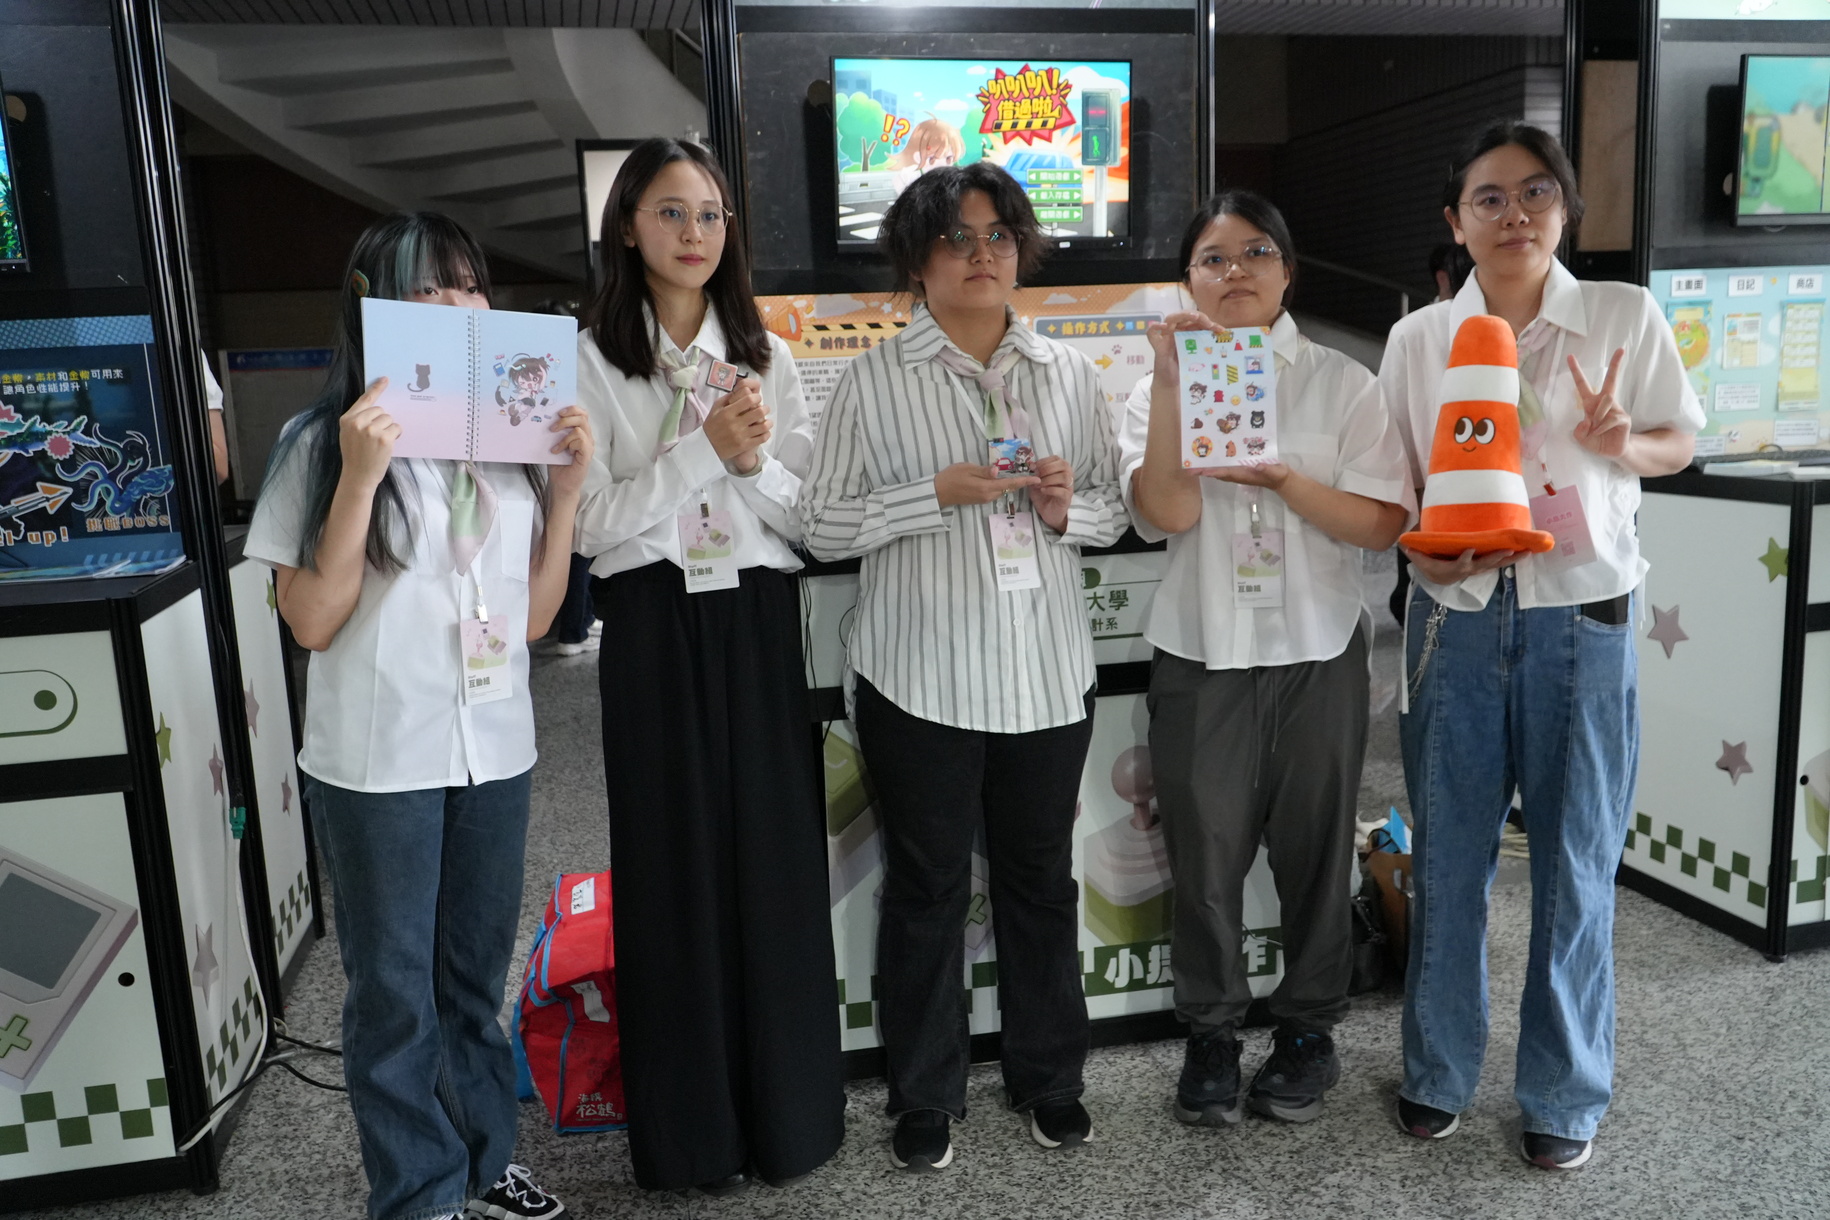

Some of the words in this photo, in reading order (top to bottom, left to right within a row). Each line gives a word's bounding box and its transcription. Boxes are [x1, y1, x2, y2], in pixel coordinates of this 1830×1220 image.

[997, 96, 1062, 120] 借過啦
[1675, 278, 1704, 291] 主畫面
[1737, 279, 1755, 291] 日記
[1796, 278, 1814, 289] 商店
[1062, 320, 1110, 336] 操作方式
[820, 335, 872, 350] 創作理念
[0, 529, 14, 547] l
[27, 526, 69, 547] up!
[689, 567, 713, 577] 互動組
[1237, 584, 1261, 593] 互動組
[1086, 589, 1129, 611] 大學
[1091, 617, 1118, 631] 計系
[468, 676, 491, 689] 互動組
